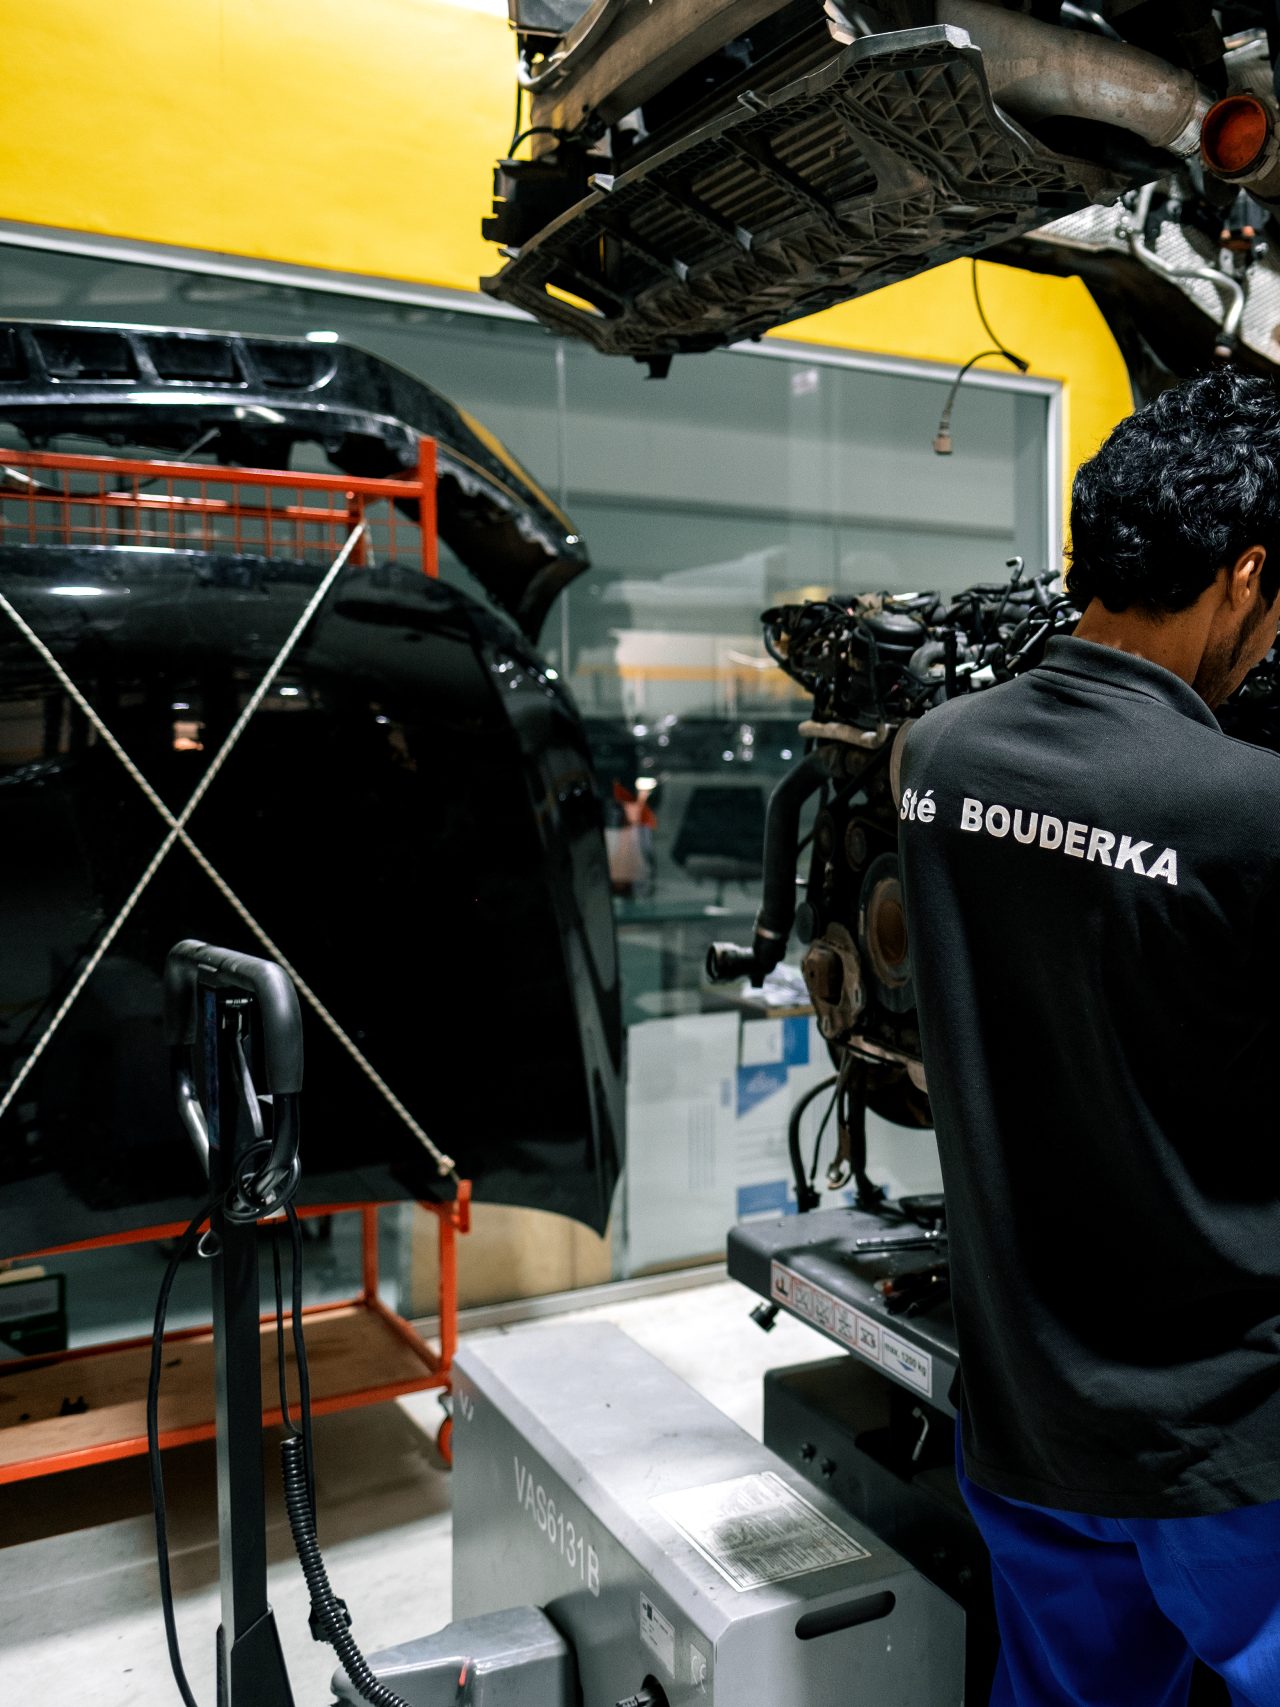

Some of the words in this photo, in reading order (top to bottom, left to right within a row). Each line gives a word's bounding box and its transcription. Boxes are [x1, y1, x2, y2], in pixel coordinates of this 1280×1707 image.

[901, 788, 937, 823] Sté
[960, 797, 1178, 886] BOUDERKA
[514, 1456, 600, 1598] VAS6131B
